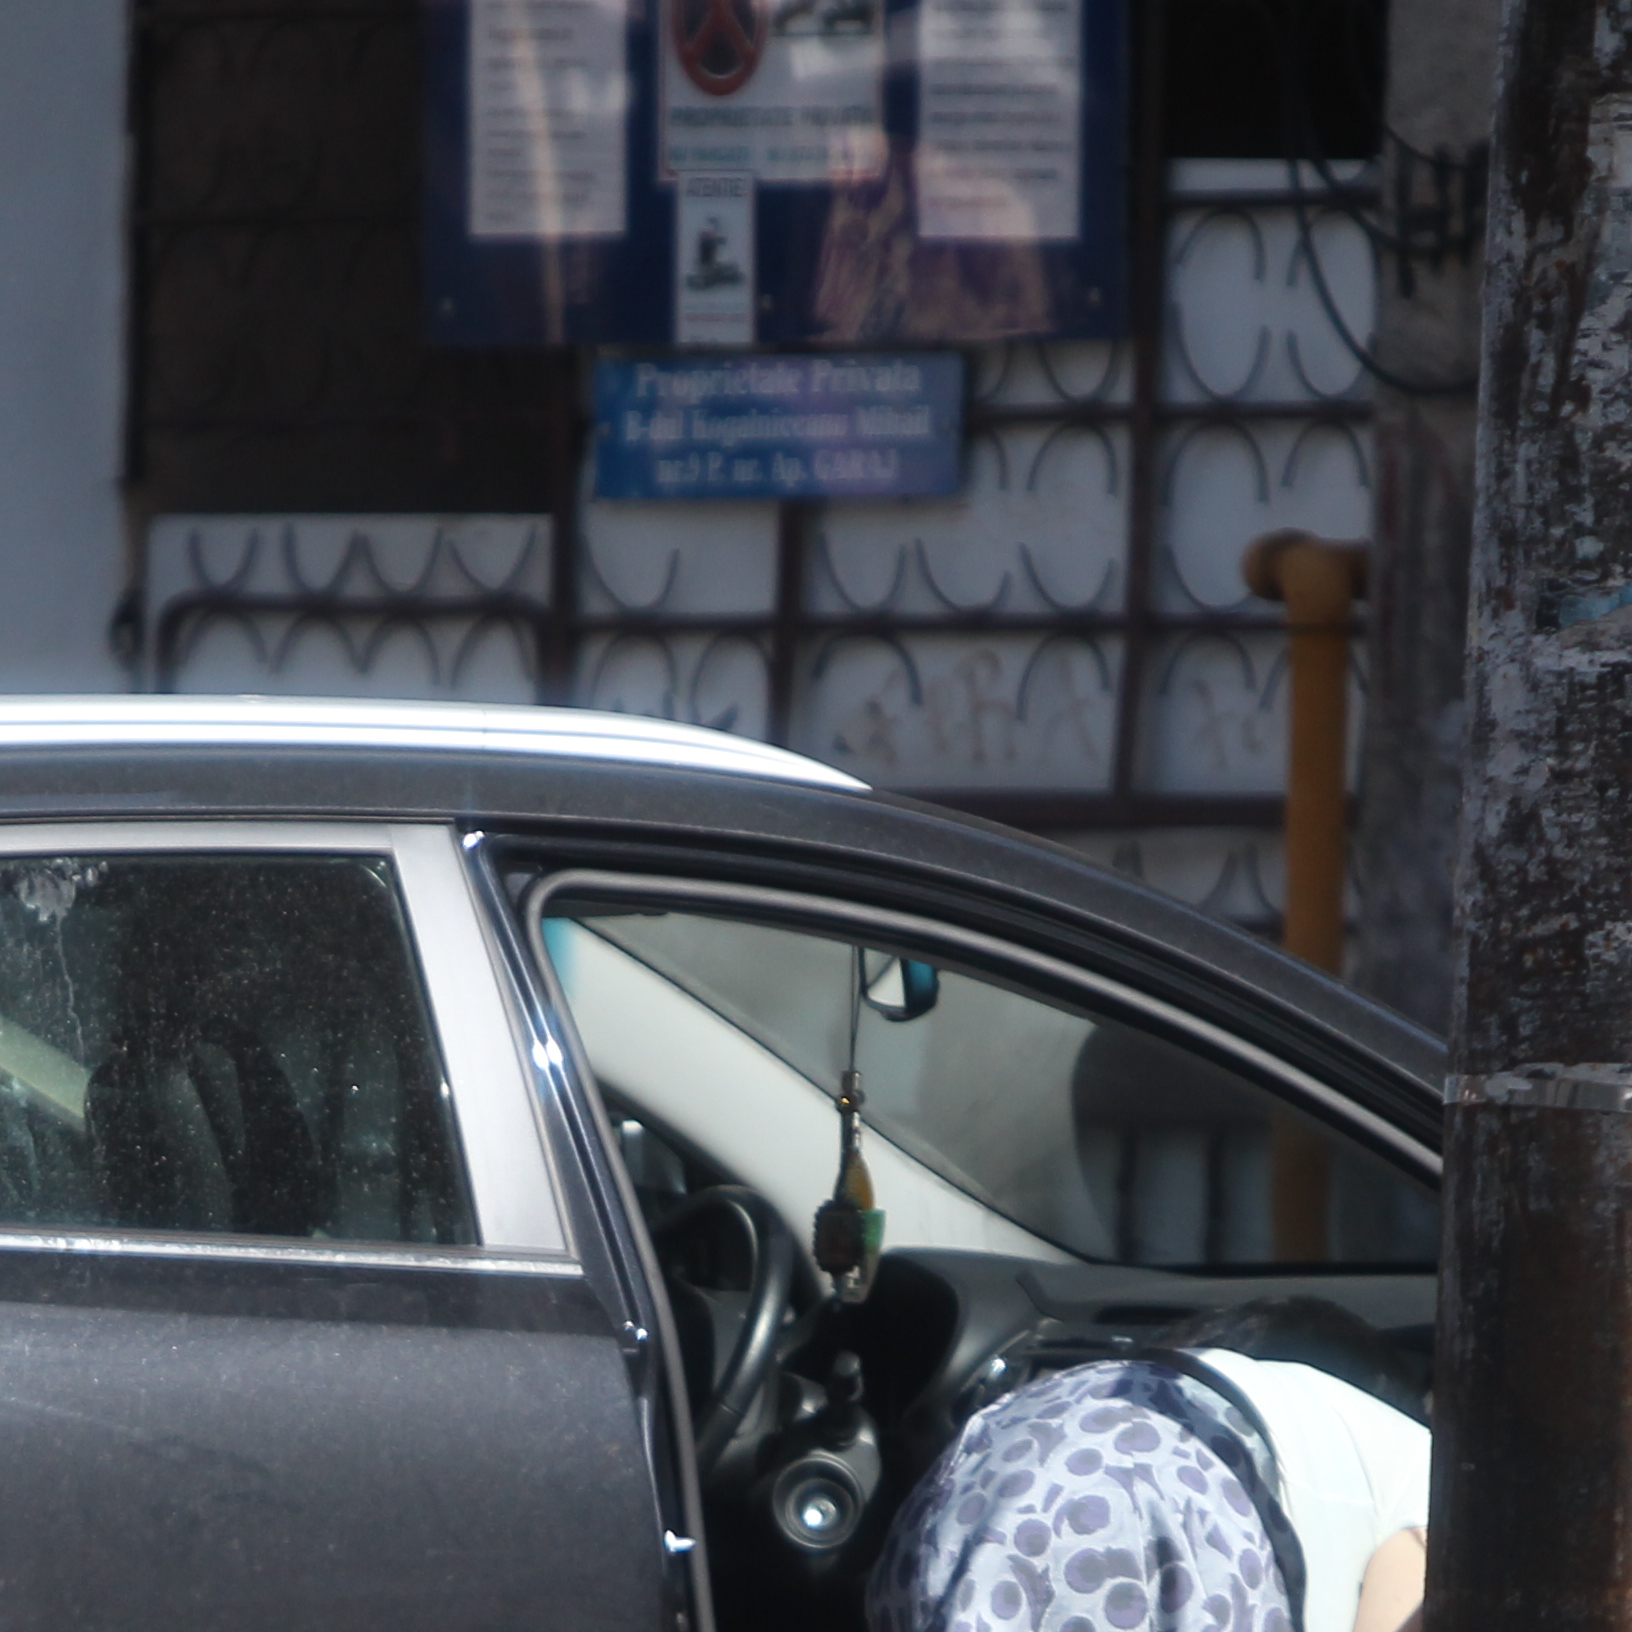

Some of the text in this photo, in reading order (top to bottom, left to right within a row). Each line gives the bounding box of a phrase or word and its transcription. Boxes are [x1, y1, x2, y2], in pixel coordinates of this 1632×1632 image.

[635, 361, 804, 403] Proprietate
[623, 409, 685, 442] B-dul
[855, 403, 932, 438] Mihail
[813, 447, 900, 481] GARAJ
